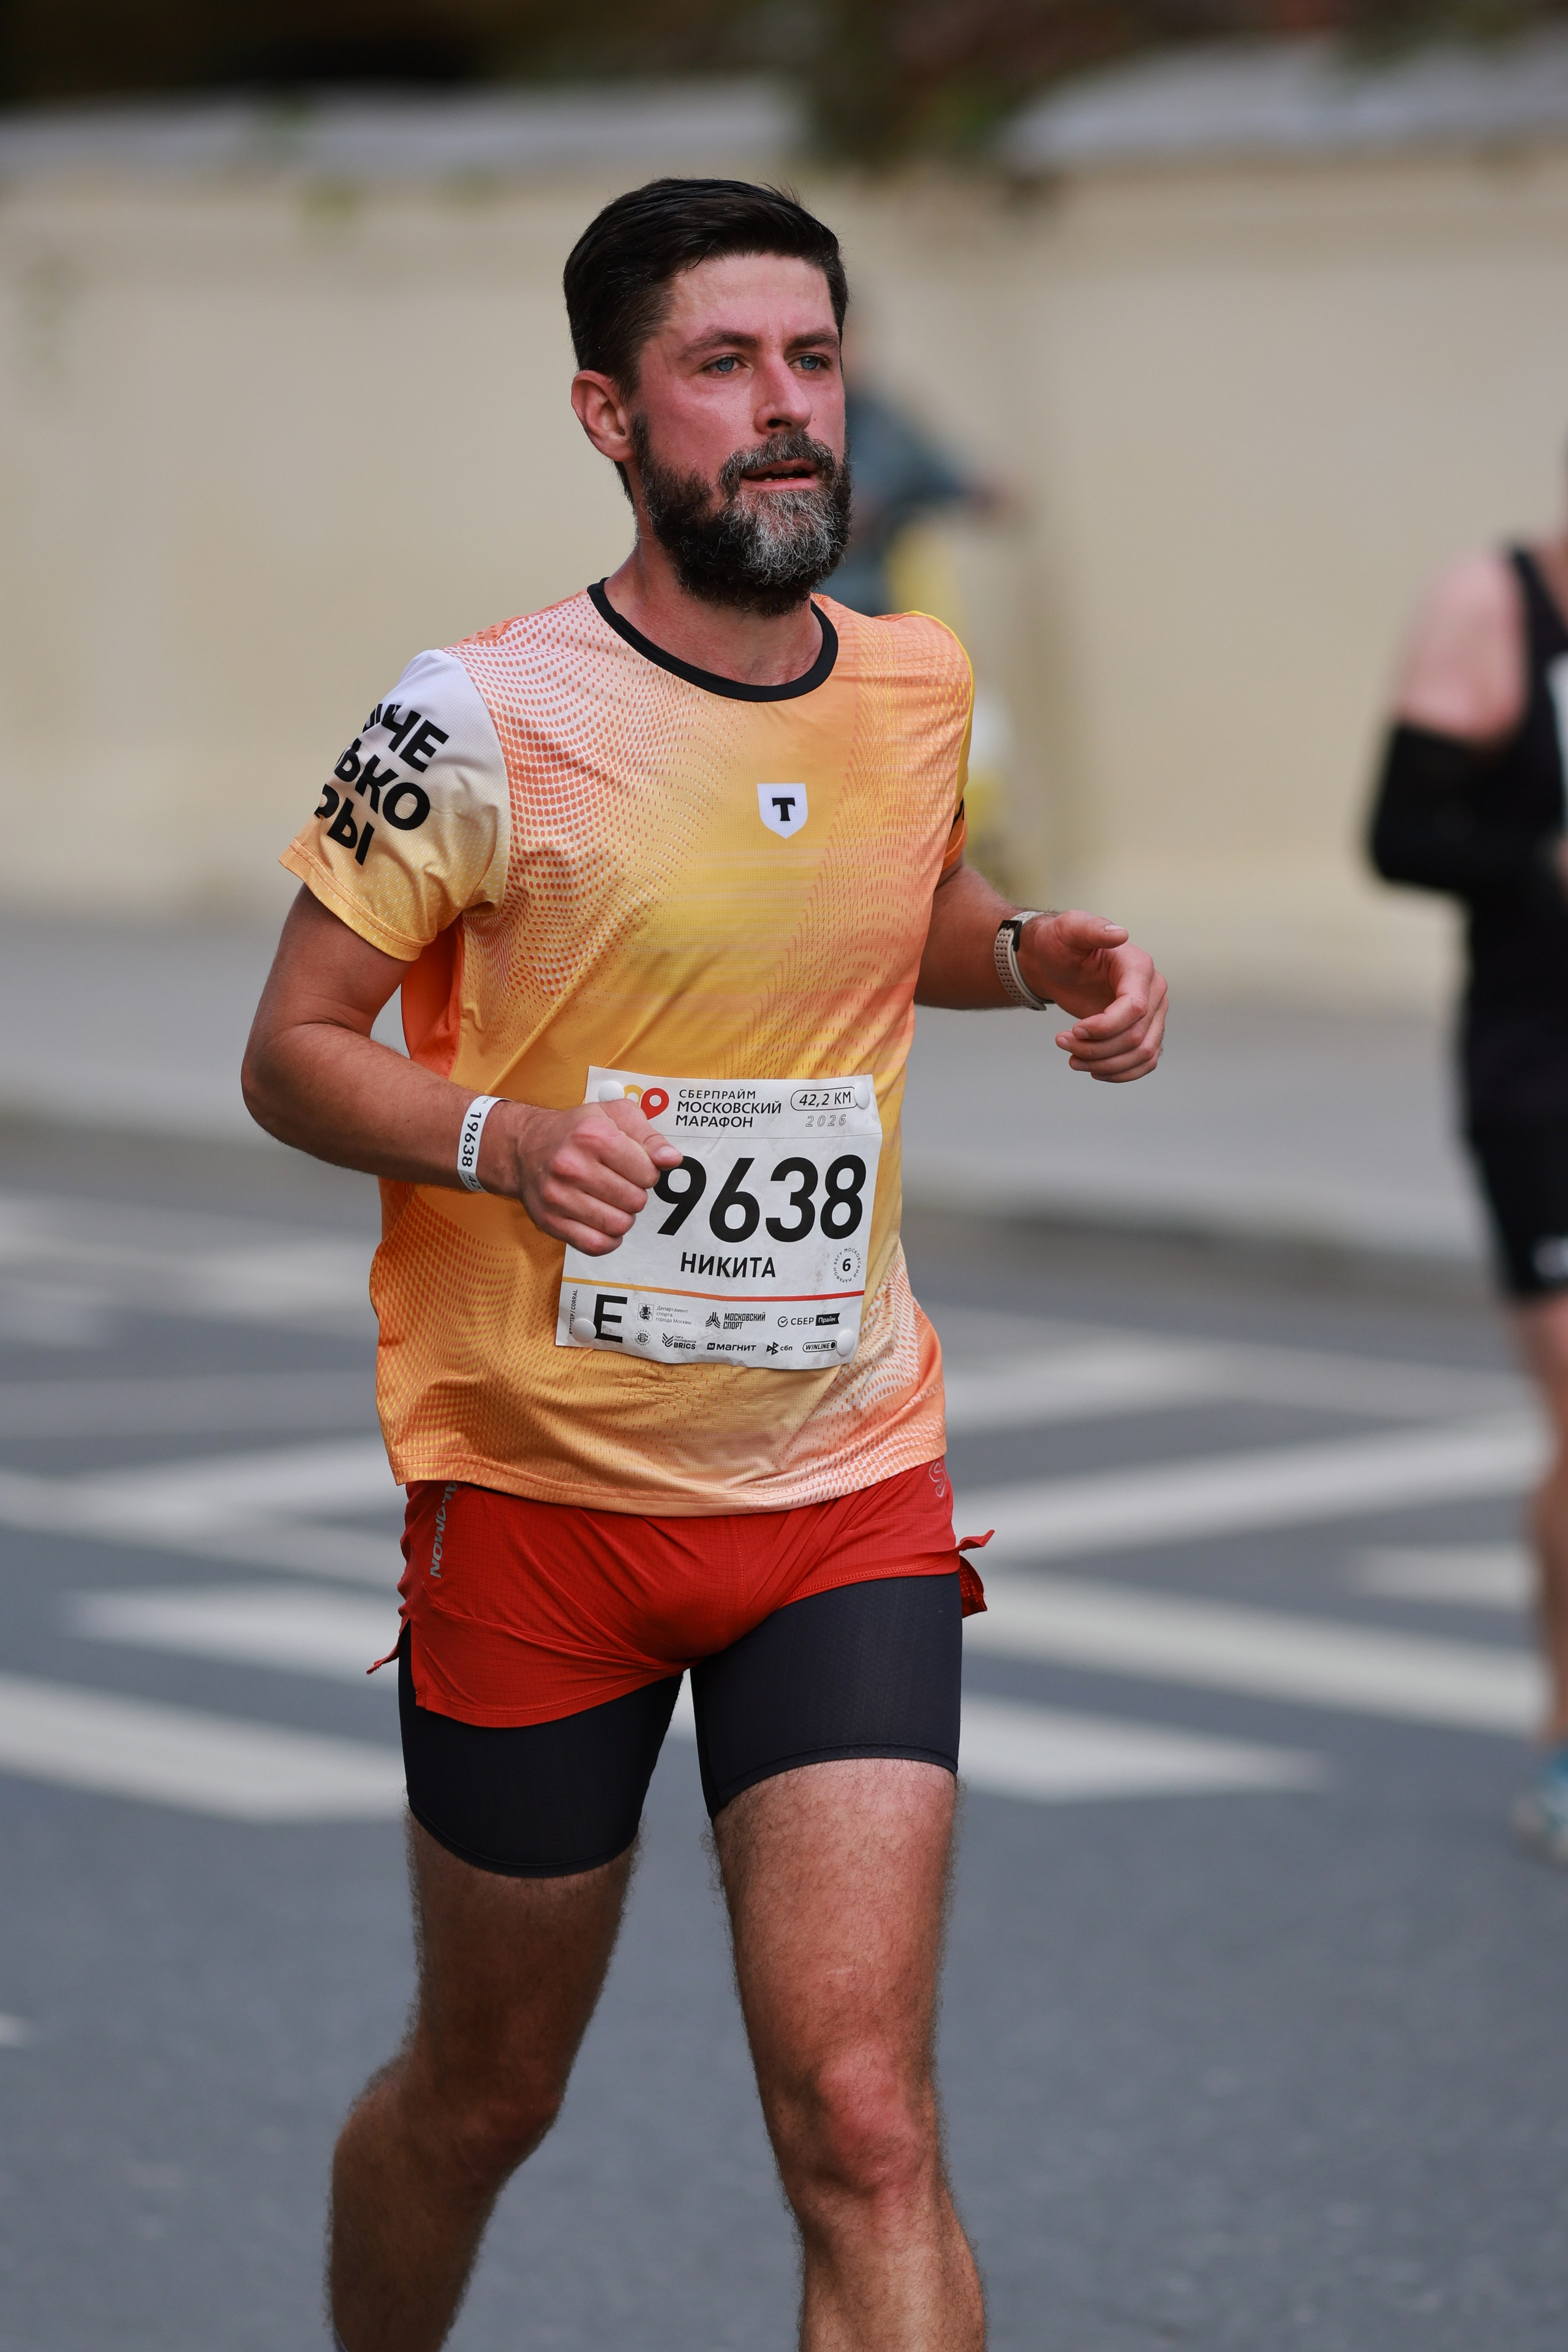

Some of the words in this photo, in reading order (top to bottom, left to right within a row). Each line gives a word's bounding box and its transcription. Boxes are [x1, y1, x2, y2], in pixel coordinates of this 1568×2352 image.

[334, 738, 430, 831] ЬКО
[772, 797, 795, 821] T
[679, 1089, 756, 1099] СБЕРПРАЙМ
[799, 1093, 829, 1107] 42,2
[834, 1091, 851, 1104] КМ
[677, 1100, 782, 1114] МОСКОВСКИЙ
[676, 1115, 753, 1128] МАРАФОН
[805, 1114, 846, 1128] 2026
[461, 1112, 481, 1167] 19638
[680, 1252, 776, 1278] НИКИТА
[842, 1258, 851, 1272] 6
[724, 1312, 766, 1321] МОСКОВСКИЙ
